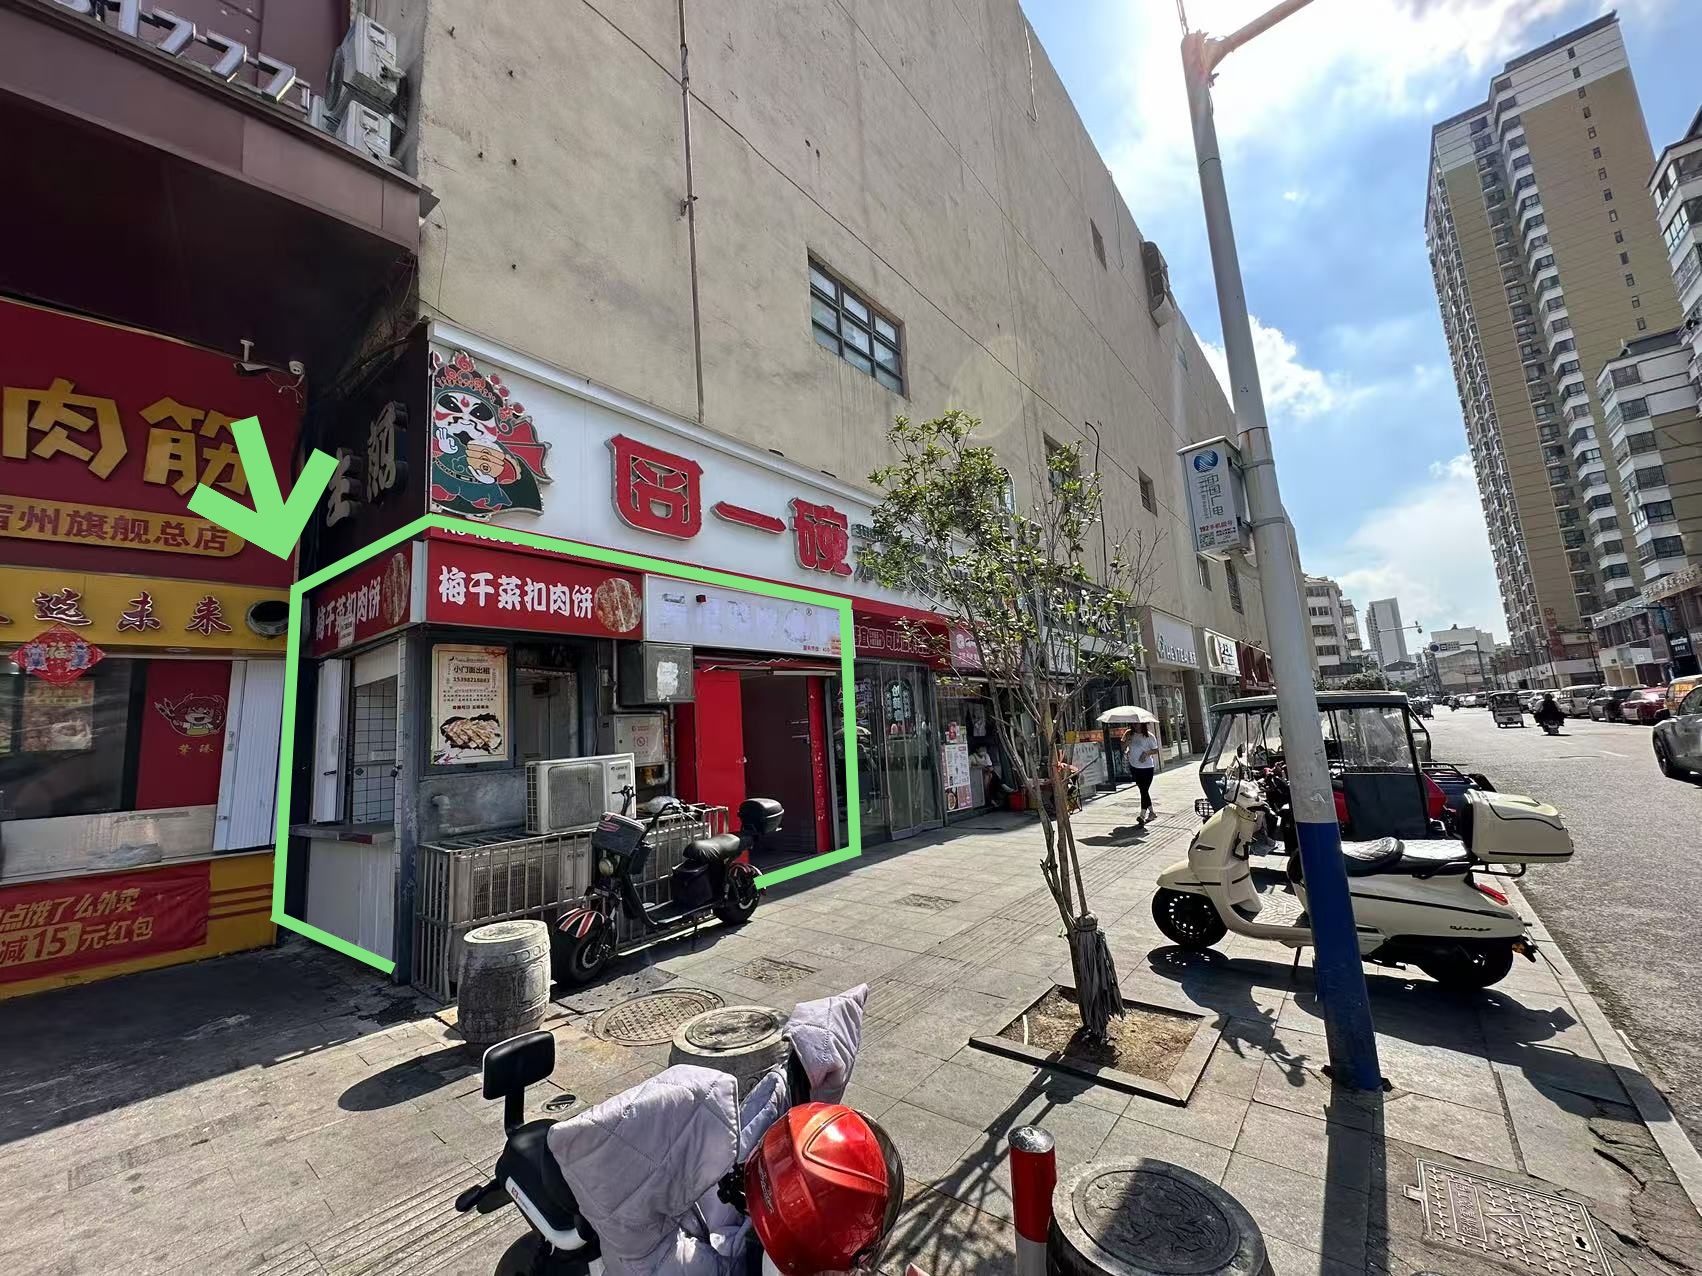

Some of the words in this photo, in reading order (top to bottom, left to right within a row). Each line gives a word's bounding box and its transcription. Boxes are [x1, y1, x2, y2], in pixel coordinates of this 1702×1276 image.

[0, 587, 233, 637] 造未来
[438, 564, 594, 620] 梅干菜扣肉饼
[453, 667, 490, 675] 小门面出租
[0, 887, 141, 931] 点饿了么外卖
